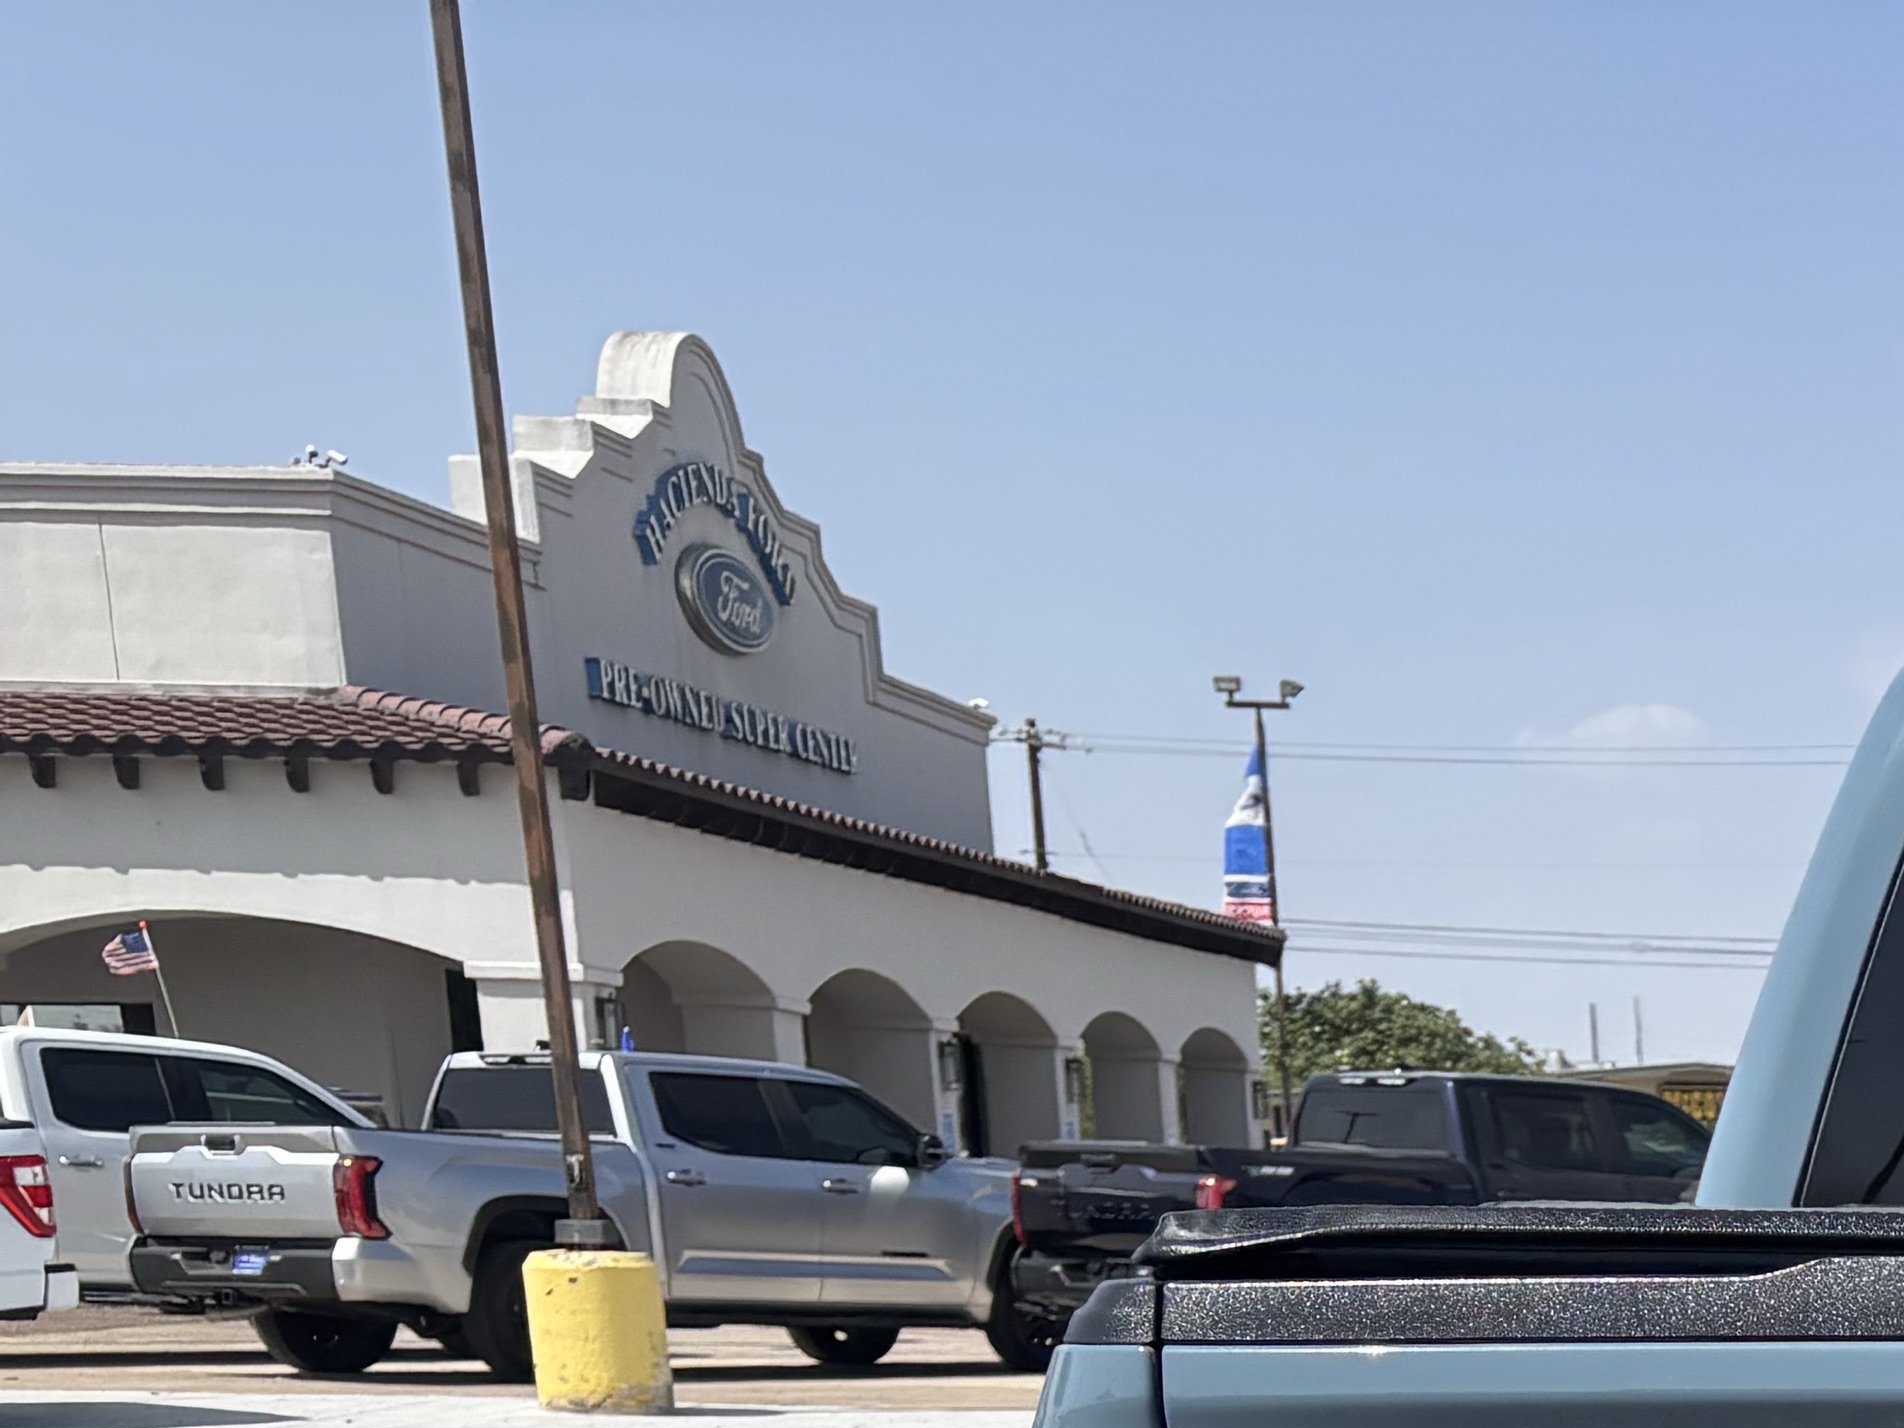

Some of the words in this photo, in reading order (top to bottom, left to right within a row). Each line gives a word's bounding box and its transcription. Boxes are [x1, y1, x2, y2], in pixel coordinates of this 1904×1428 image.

[716, 570, 762, 633] Ford
[601, 659, 724, 732] PRE-OWNED
[171, 1182, 286, 1202] TUNDRA
